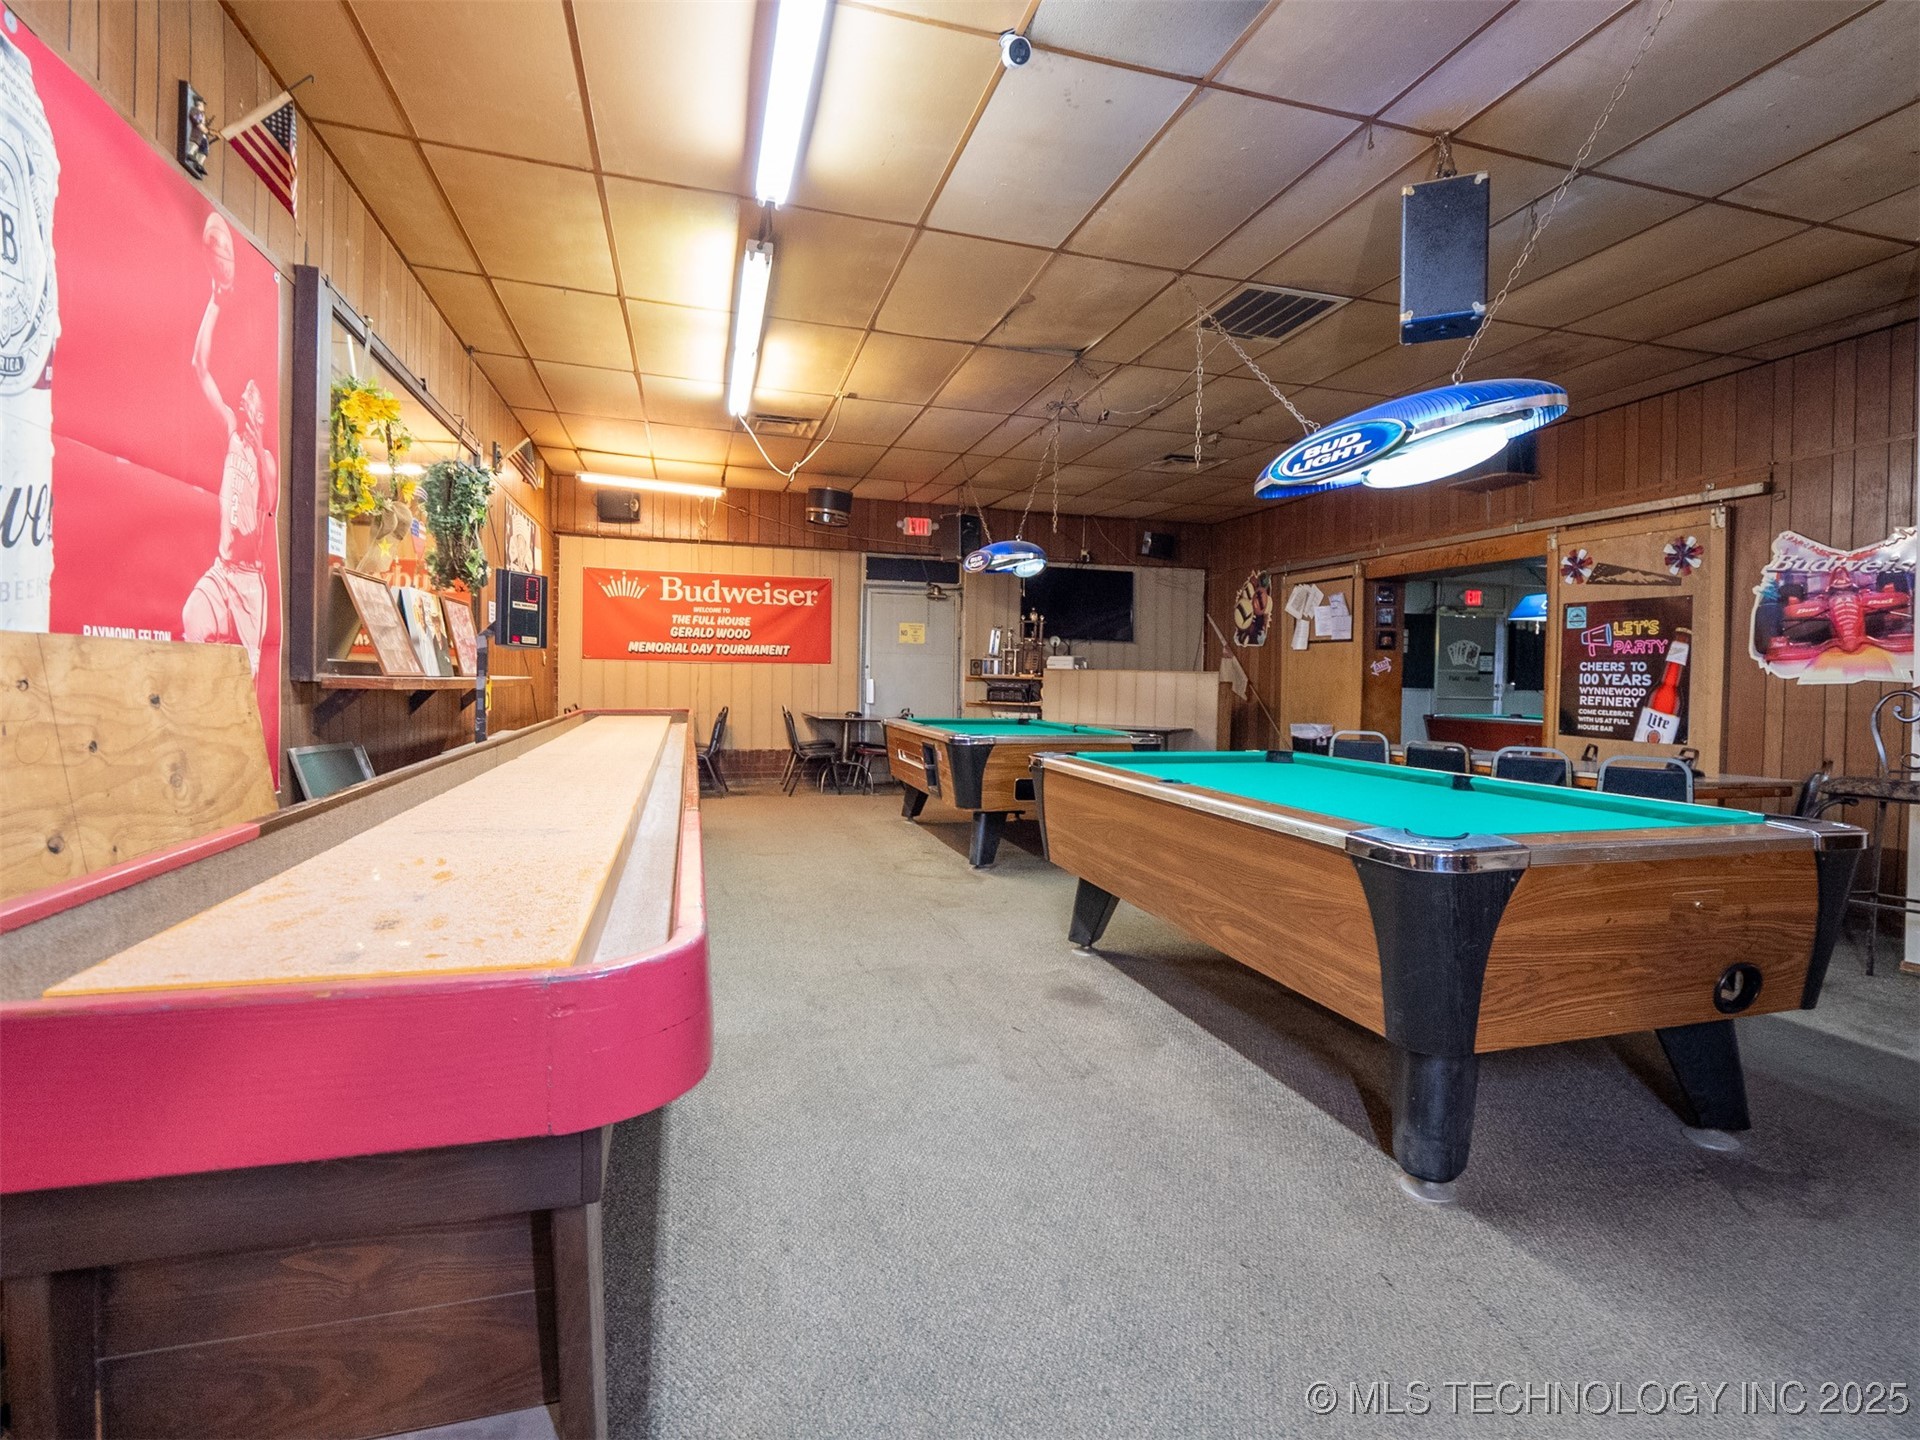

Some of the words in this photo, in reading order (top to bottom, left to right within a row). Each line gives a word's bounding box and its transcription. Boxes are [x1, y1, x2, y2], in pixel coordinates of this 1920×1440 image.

[1, 212, 18, 265] B
[0, 356, 21, 371] RICA
[1302, 432, 1362, 460] BUD
[1291, 439, 1372, 475] LIGHT
[908, 518, 928, 534] EXIT
[970, 555, 983, 563] BUD
[526, 577, 539, 603] 0
[658, 575, 818, 607] Budweiser
[1467, 591, 1482, 605] EXIT
[1797, 606, 1820, 615] Bud
[1868, 598, 1893, 606] Bud
[672, 614, 691, 625] THE
[692, 615, 715, 626] FULL
[717, 616, 751, 627] HOUSE
[1613, 619, 1660, 636] LET'S
[670, 626, 715, 639] GERALD
[716, 628, 751, 640] WOOD
[900, 629, 908, 637] NO
[628, 641, 689, 655] MEMORIAL
[690, 643, 714, 656] DAY
[715, 644, 790, 657] TOURNAMENT
[1613, 639, 1669, 655] PARTY
[1579, 661, 1626, 672] CHEERS
[1630, 661, 1647, 672] TO
[1579, 673, 1600, 685] 100
[1602, 674, 1652, 687] YEARS
[1579, 686, 1647, 697] WYNNEWOOD
[1579, 696, 1641, 708] REFINERY
[1578, 708, 1597, 716] COME
[1597, 709, 1634, 718] CELEBRATE
[1578, 723, 1599, 731] HOUSE
[1599, 725, 1614, 733] BAR
[1594, 716, 1604, 724] US
[1613, 718, 1630, 726] FULL
[1646, 712, 1670, 730] Lite
